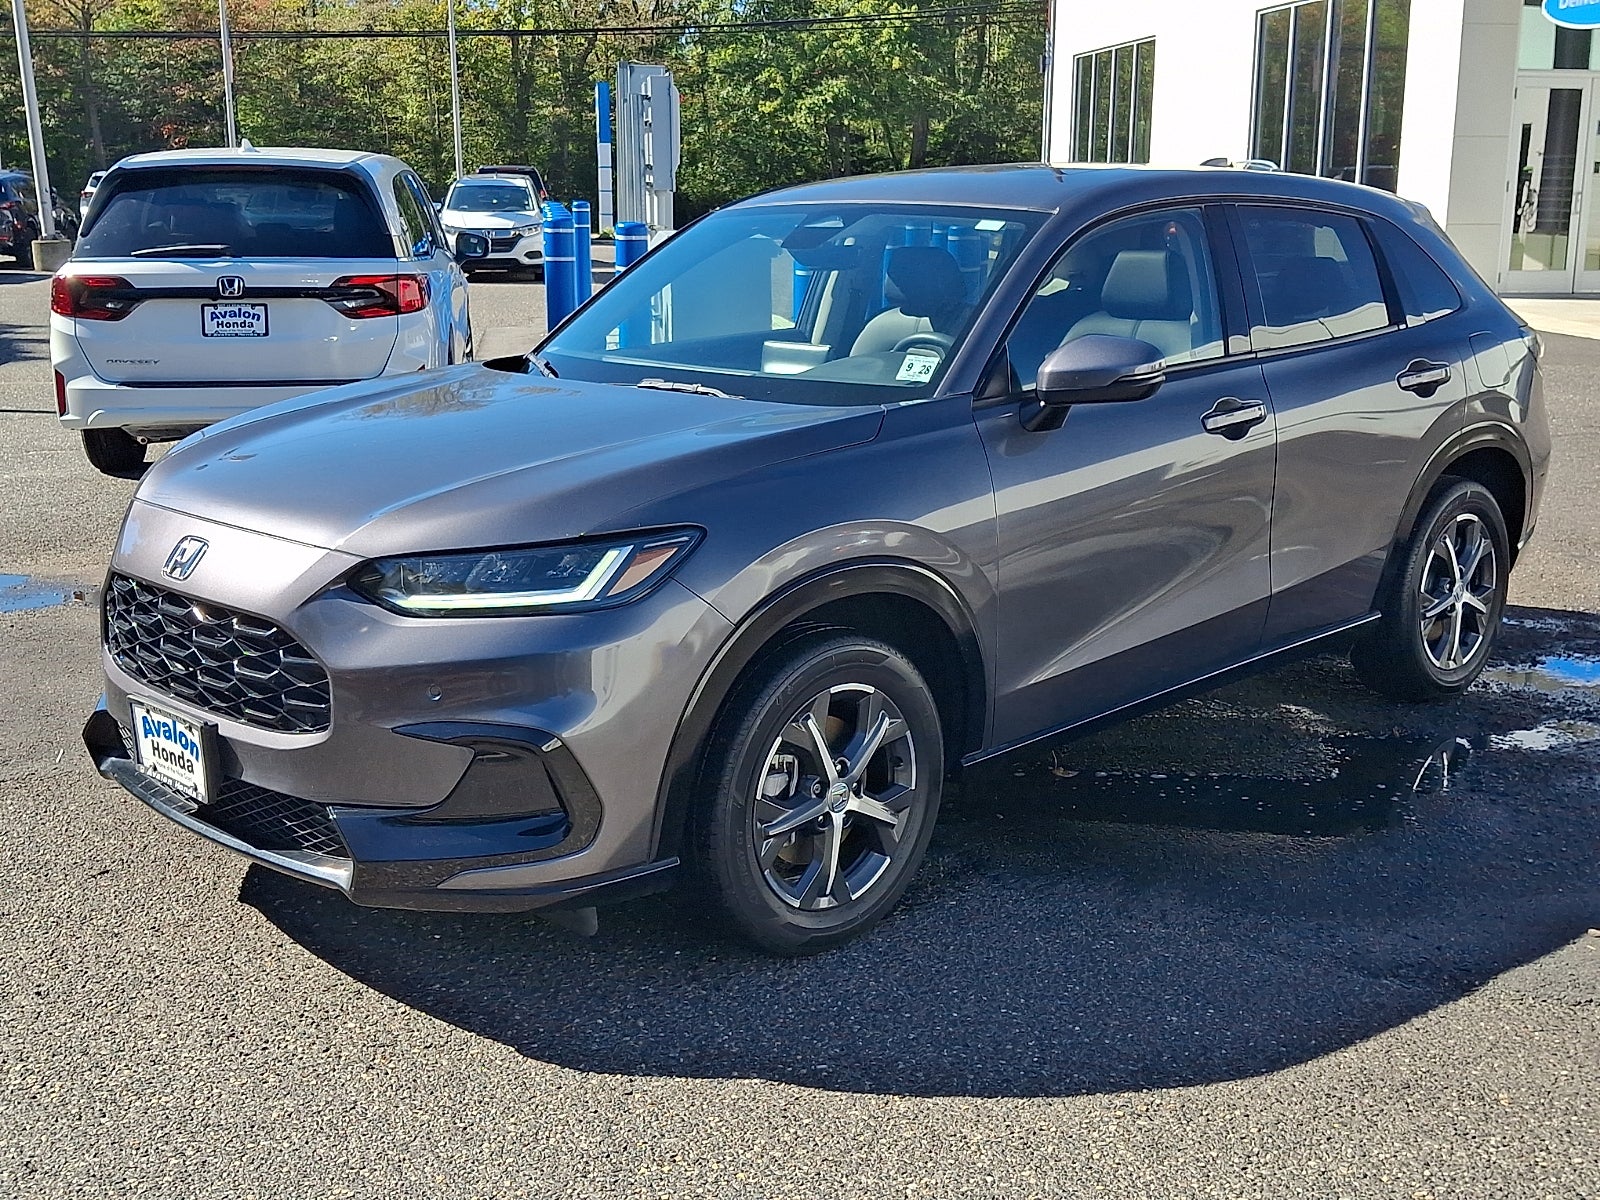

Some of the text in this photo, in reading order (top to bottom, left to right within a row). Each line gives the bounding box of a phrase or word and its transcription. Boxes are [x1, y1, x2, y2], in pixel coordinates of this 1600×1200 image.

[210, 308, 261, 321] Avalon
[216, 320, 254, 328] Honda
[905, 362, 932, 375] 9 28
[142, 715, 200, 762] Avalon
[151, 739, 195, 775] Honda
